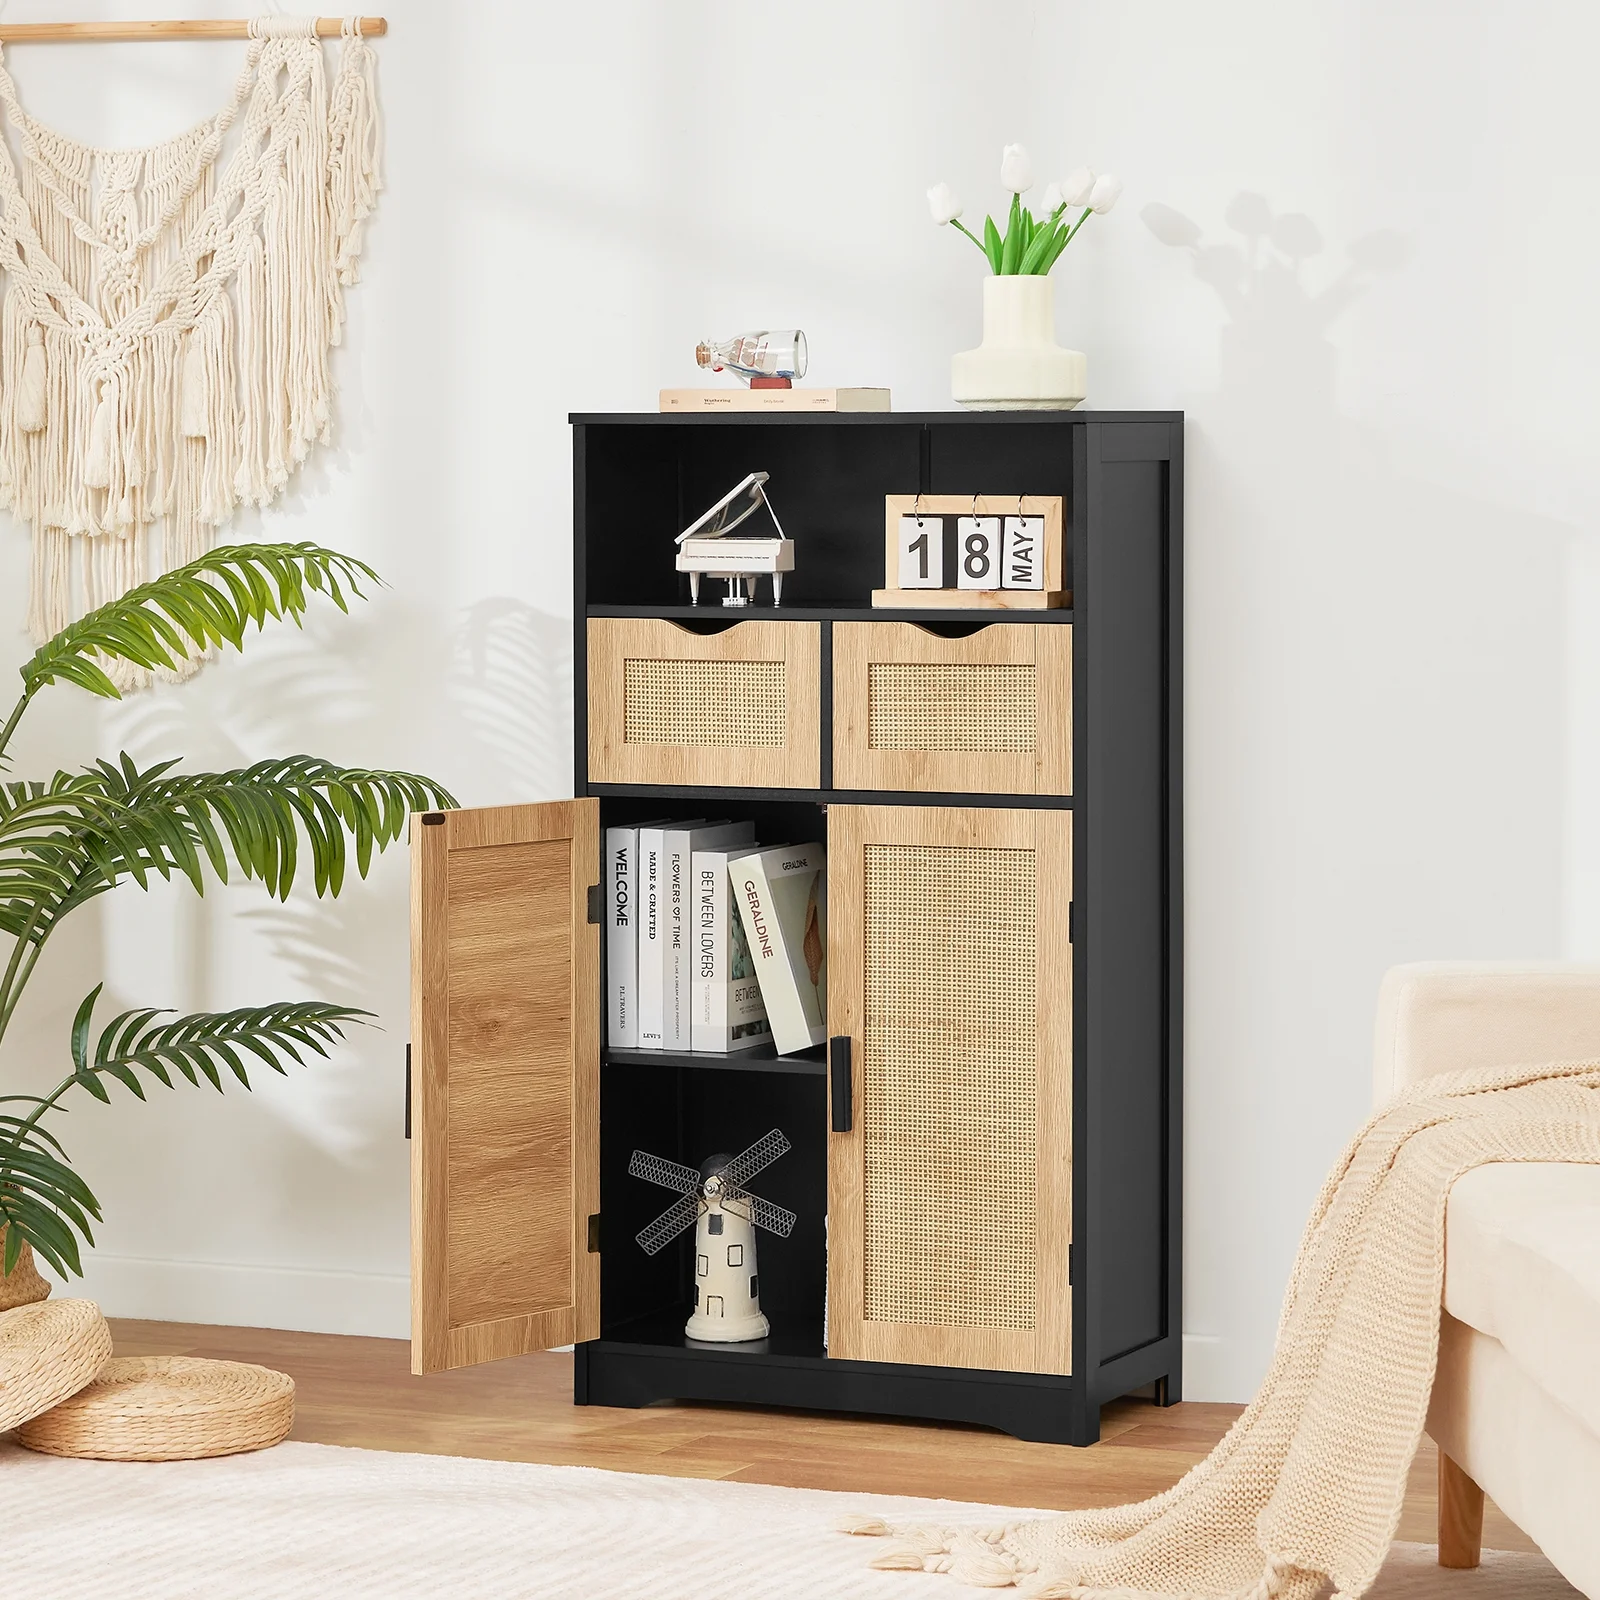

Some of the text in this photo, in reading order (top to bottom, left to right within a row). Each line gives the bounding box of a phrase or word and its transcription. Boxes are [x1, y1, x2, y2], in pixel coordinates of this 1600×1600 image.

[908, 531, 1034, 582] 1 8 MAY
[615, 847, 628, 926] WELCOME
[649, 883, 656, 891] &
[782, 858, 808, 871] GERALDINE
[701, 871, 714, 928] BETWEEN
[744, 880, 774, 959] GERALDINE
[672, 925, 681, 949] TIME
[701, 932, 714, 978] LOVERS
[735, 985, 760, 1002] BETWEEN
